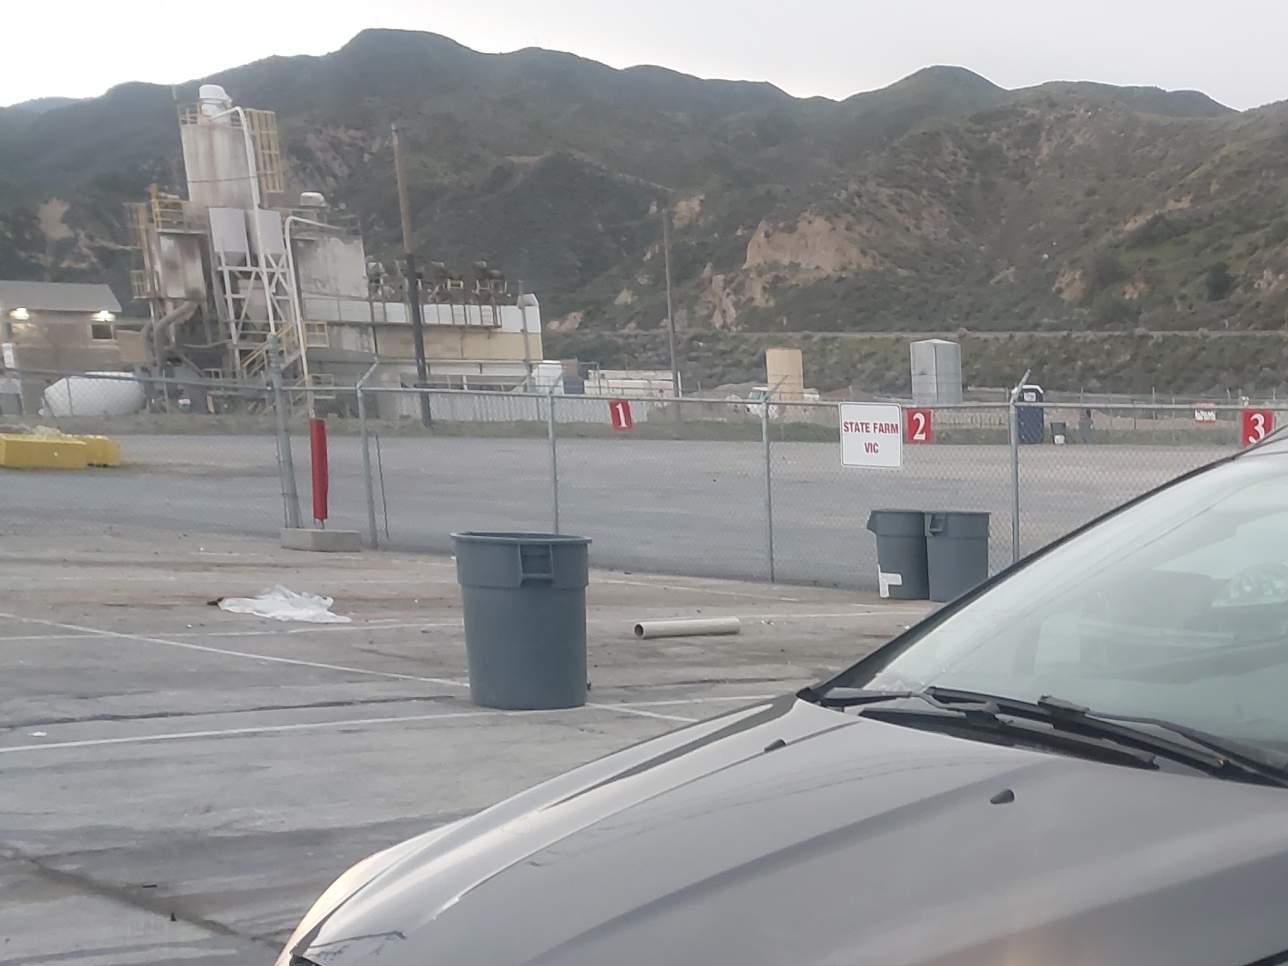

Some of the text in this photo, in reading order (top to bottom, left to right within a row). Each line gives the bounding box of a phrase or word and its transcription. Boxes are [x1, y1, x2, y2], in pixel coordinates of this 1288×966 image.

[616, 403, 628, 427] 1
[912, 412, 927, 441] 2
[843, 421, 899, 434] STATE FARM
[1248, 412, 1265, 444] 3
[864, 442, 880, 454] VIC
